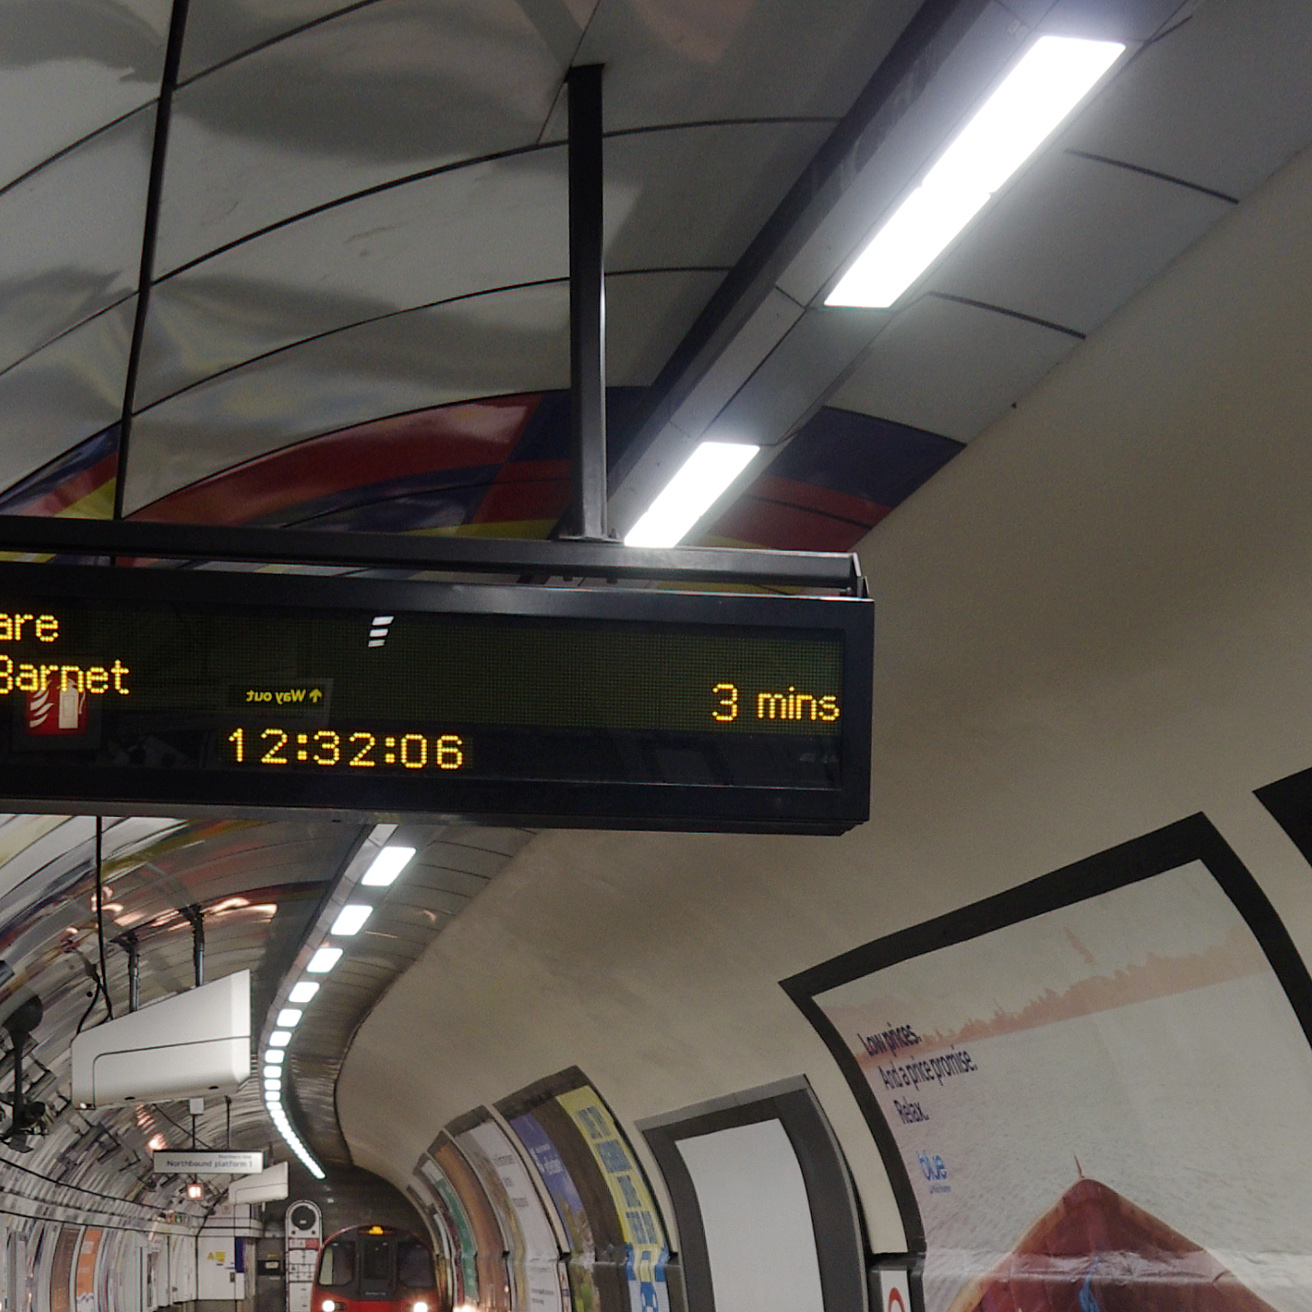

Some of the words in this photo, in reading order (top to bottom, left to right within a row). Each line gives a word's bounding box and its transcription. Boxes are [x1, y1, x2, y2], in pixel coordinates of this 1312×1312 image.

[711, 683, 739, 722] 3
[756, 686, 842, 722] mins
[228, 727, 465, 770] 12:32:06
[857, 1032, 886, 1057] Low
[883, 1021, 923, 1058] prices.
[878, 1062, 901, 1091] And
[906, 1055, 935, 1092] price
[930, 1044, 979, 1087] promise.
[893, 1096, 930, 1125] Relax.
[167, 1160, 213, 1168] Northbound
[214, 1160, 248, 1169] platform
[916, 1150, 948, 1181] blue
